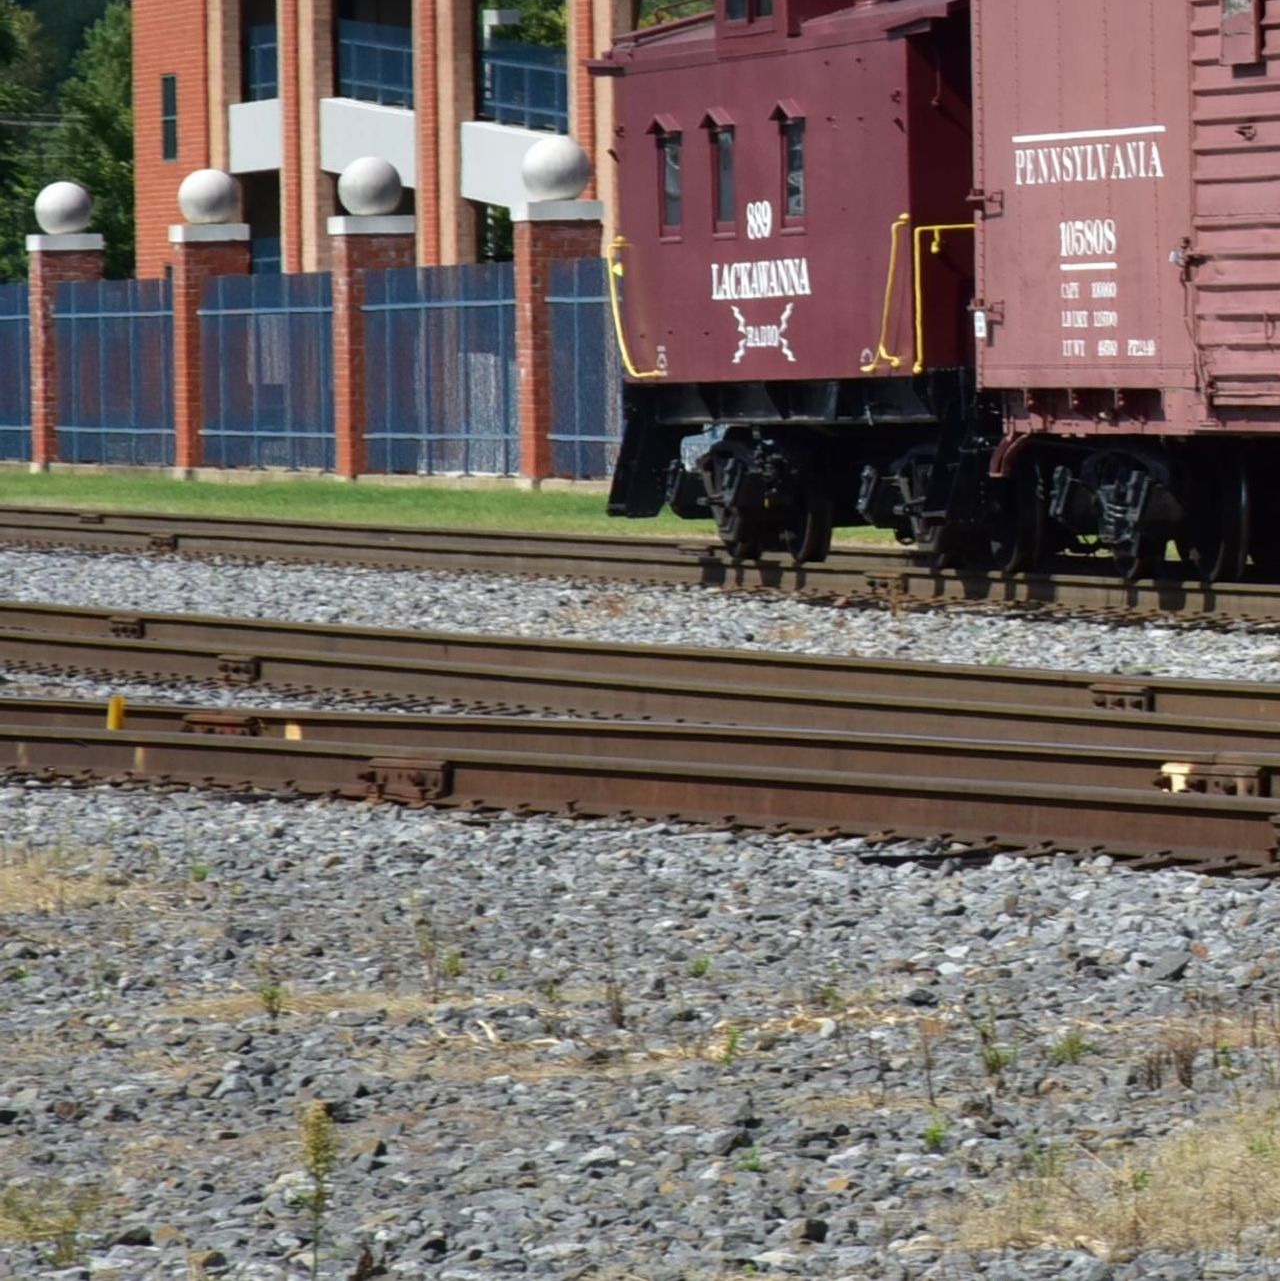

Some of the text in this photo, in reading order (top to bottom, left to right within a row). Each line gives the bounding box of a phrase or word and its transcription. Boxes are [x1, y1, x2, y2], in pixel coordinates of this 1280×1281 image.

[1014, 140, 1165, 185] PENNSYLVANIA
[746, 199, 773, 240] 889
[1059, 218, 1117, 257] 105808
[710, 257, 812, 300] LACKAWANNA
[745, 324, 780, 347] RADIO
